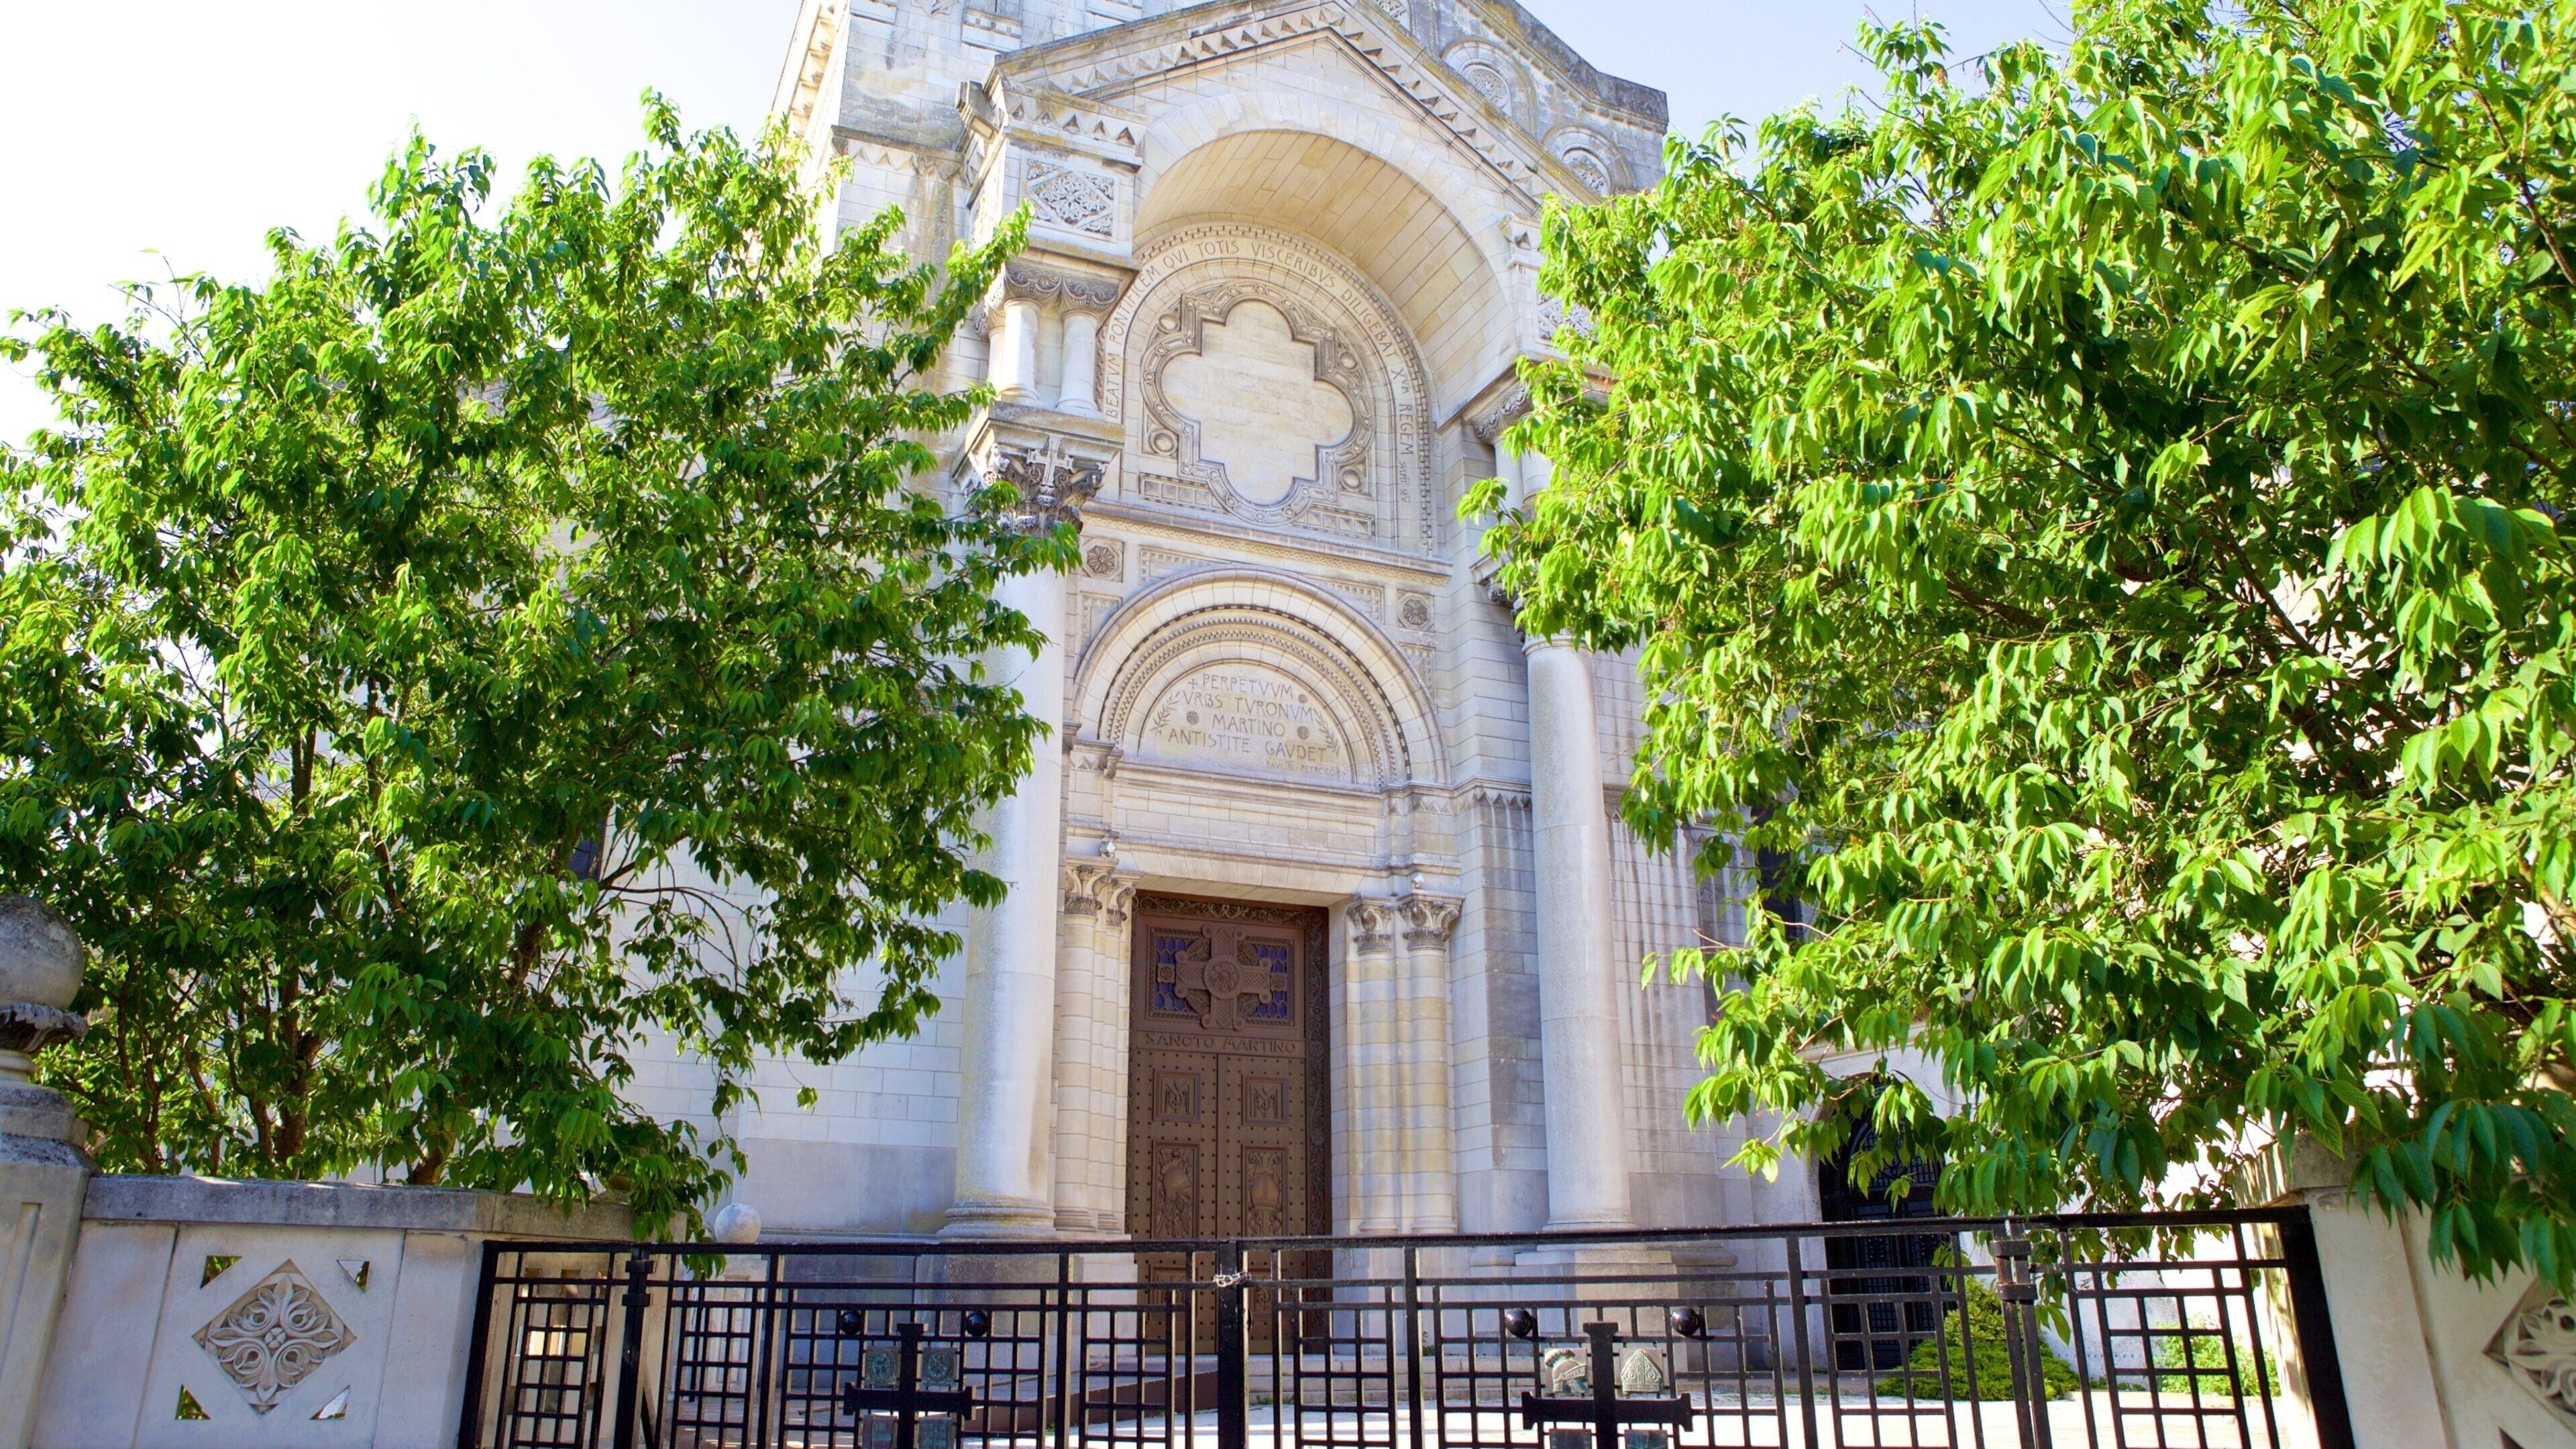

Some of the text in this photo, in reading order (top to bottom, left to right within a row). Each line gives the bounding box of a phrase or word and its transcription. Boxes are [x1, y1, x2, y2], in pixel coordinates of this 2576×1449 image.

[1163, 247, 1189, 268] QVI
[1197, 240, 1240, 256] TOTIS
[1251, 242, 1336, 288] VISCERIBVS
[1110, 265, 1161, 345] PONTIFICEM
[1340, 288, 1399, 358] DILIGEBAT
[1106, 353, 1120, 419] BEATVM
[1399, 403, 1413, 455] REGEM
[1203, 674, 1293, 699] PERPETVVM
[1183, 690, 1313, 722] VRBS TVRONVM
[1212, 714, 1285, 737] MARTINO
[1168, 728, 1326, 762] ANTISTITE GAVDET
[1146, 1032, 1295, 1054] SANCTO MARTINO
